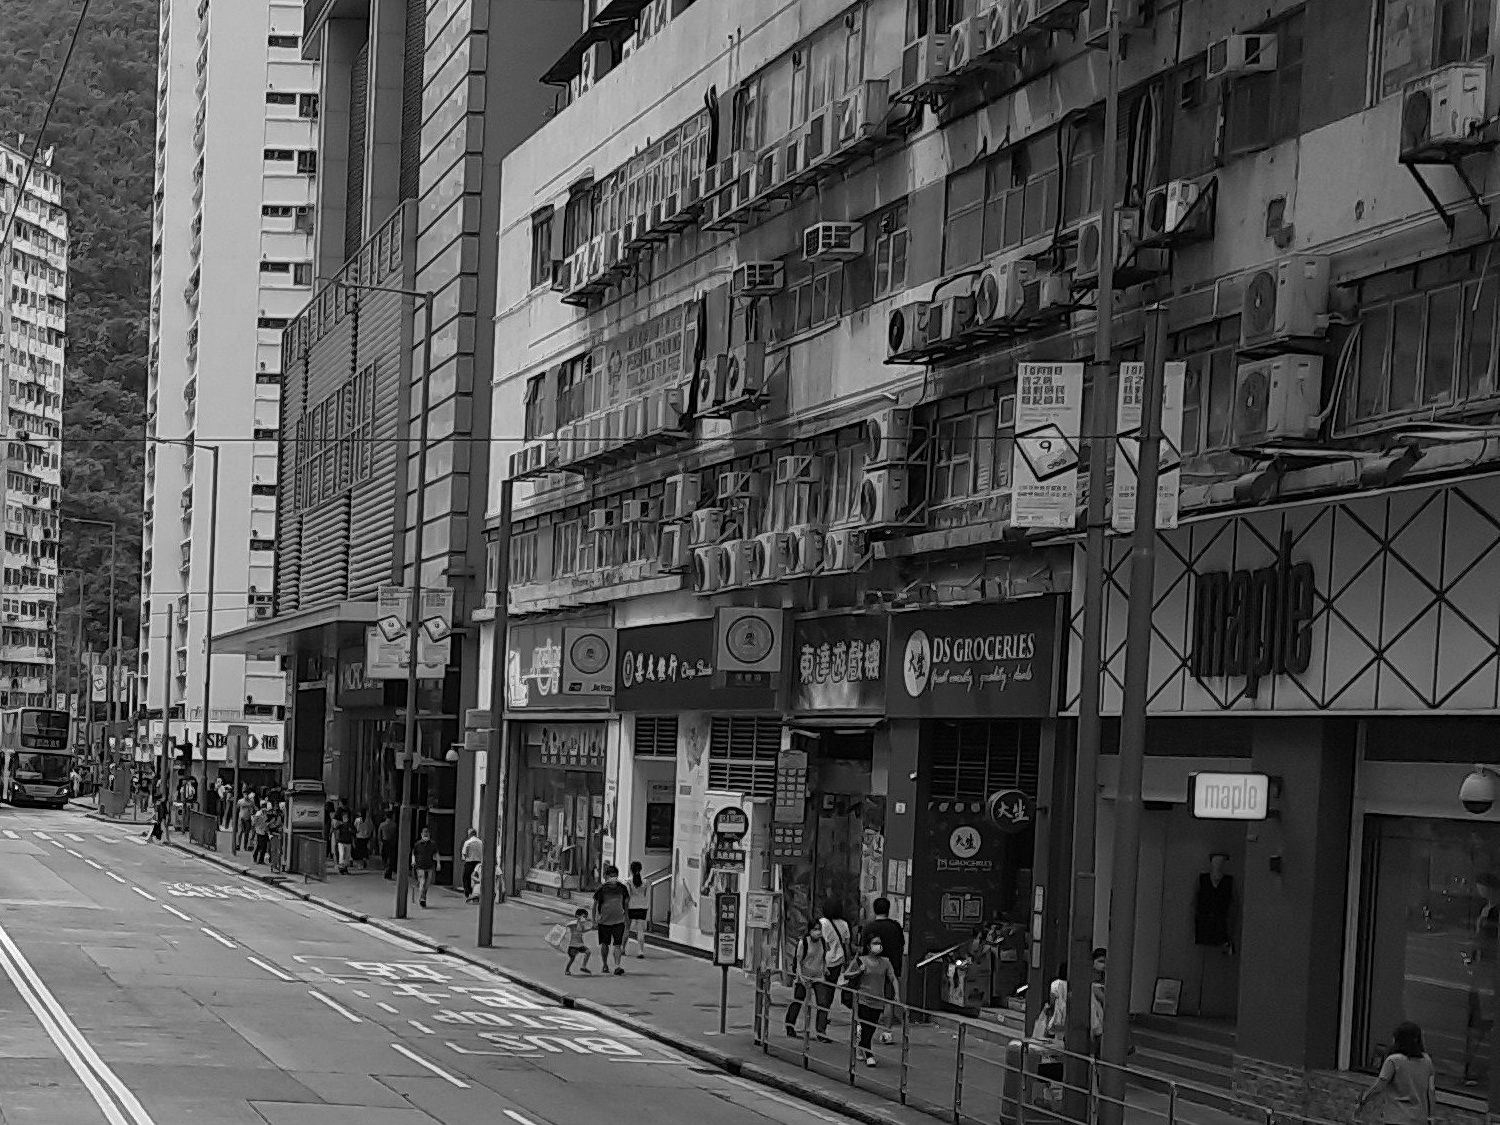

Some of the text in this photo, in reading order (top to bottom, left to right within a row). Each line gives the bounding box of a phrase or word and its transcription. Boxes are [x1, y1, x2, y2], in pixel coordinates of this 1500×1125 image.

[1039, 440, 1052, 454] 9
[1192, 531, 1314, 699] maple
[799, 638, 881, 685] 東達遊戲機
[932, 633, 1036, 663] DS GROCERIES
[997, 798, 1030, 824] 大生
[1203, 779, 1260, 815] maple
[432, 1009, 599, 1032] STOP
[478, 1032, 643, 1056] BUS
